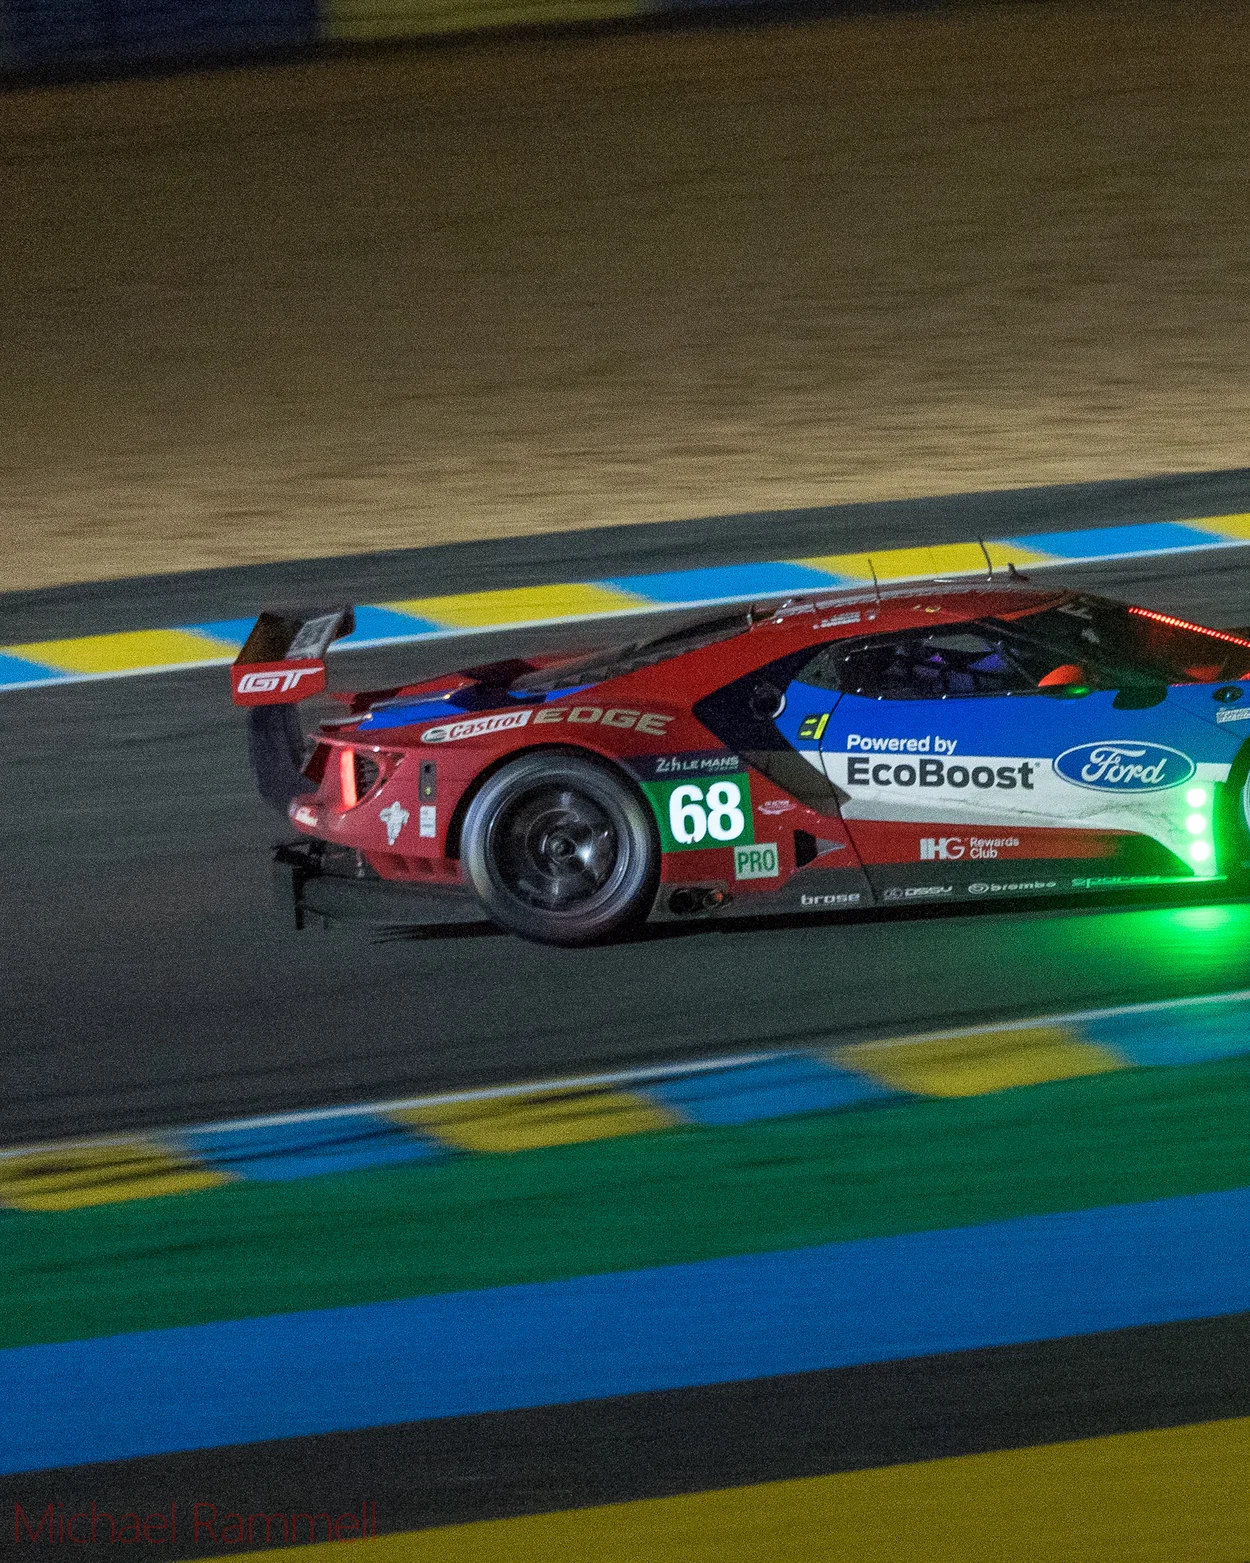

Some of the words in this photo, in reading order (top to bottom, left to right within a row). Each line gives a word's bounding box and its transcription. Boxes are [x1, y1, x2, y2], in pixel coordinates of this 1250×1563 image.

[237, 667, 325, 694] GT
[450, 713, 525, 739] Castrol
[533, 706, 676, 736] EDGE
[846, 734, 931, 752] Powered
[934, 735, 958, 756] by
[1081, 747, 1168, 785] Ford
[668, 781, 745, 845] 68
[970, 837, 1019, 848] Rewards
[970, 847, 998, 859] Club
[737, 849, 776, 874] PRO
[990, 881, 1057, 893] brembo
[801, 892, 861, 906] brose
